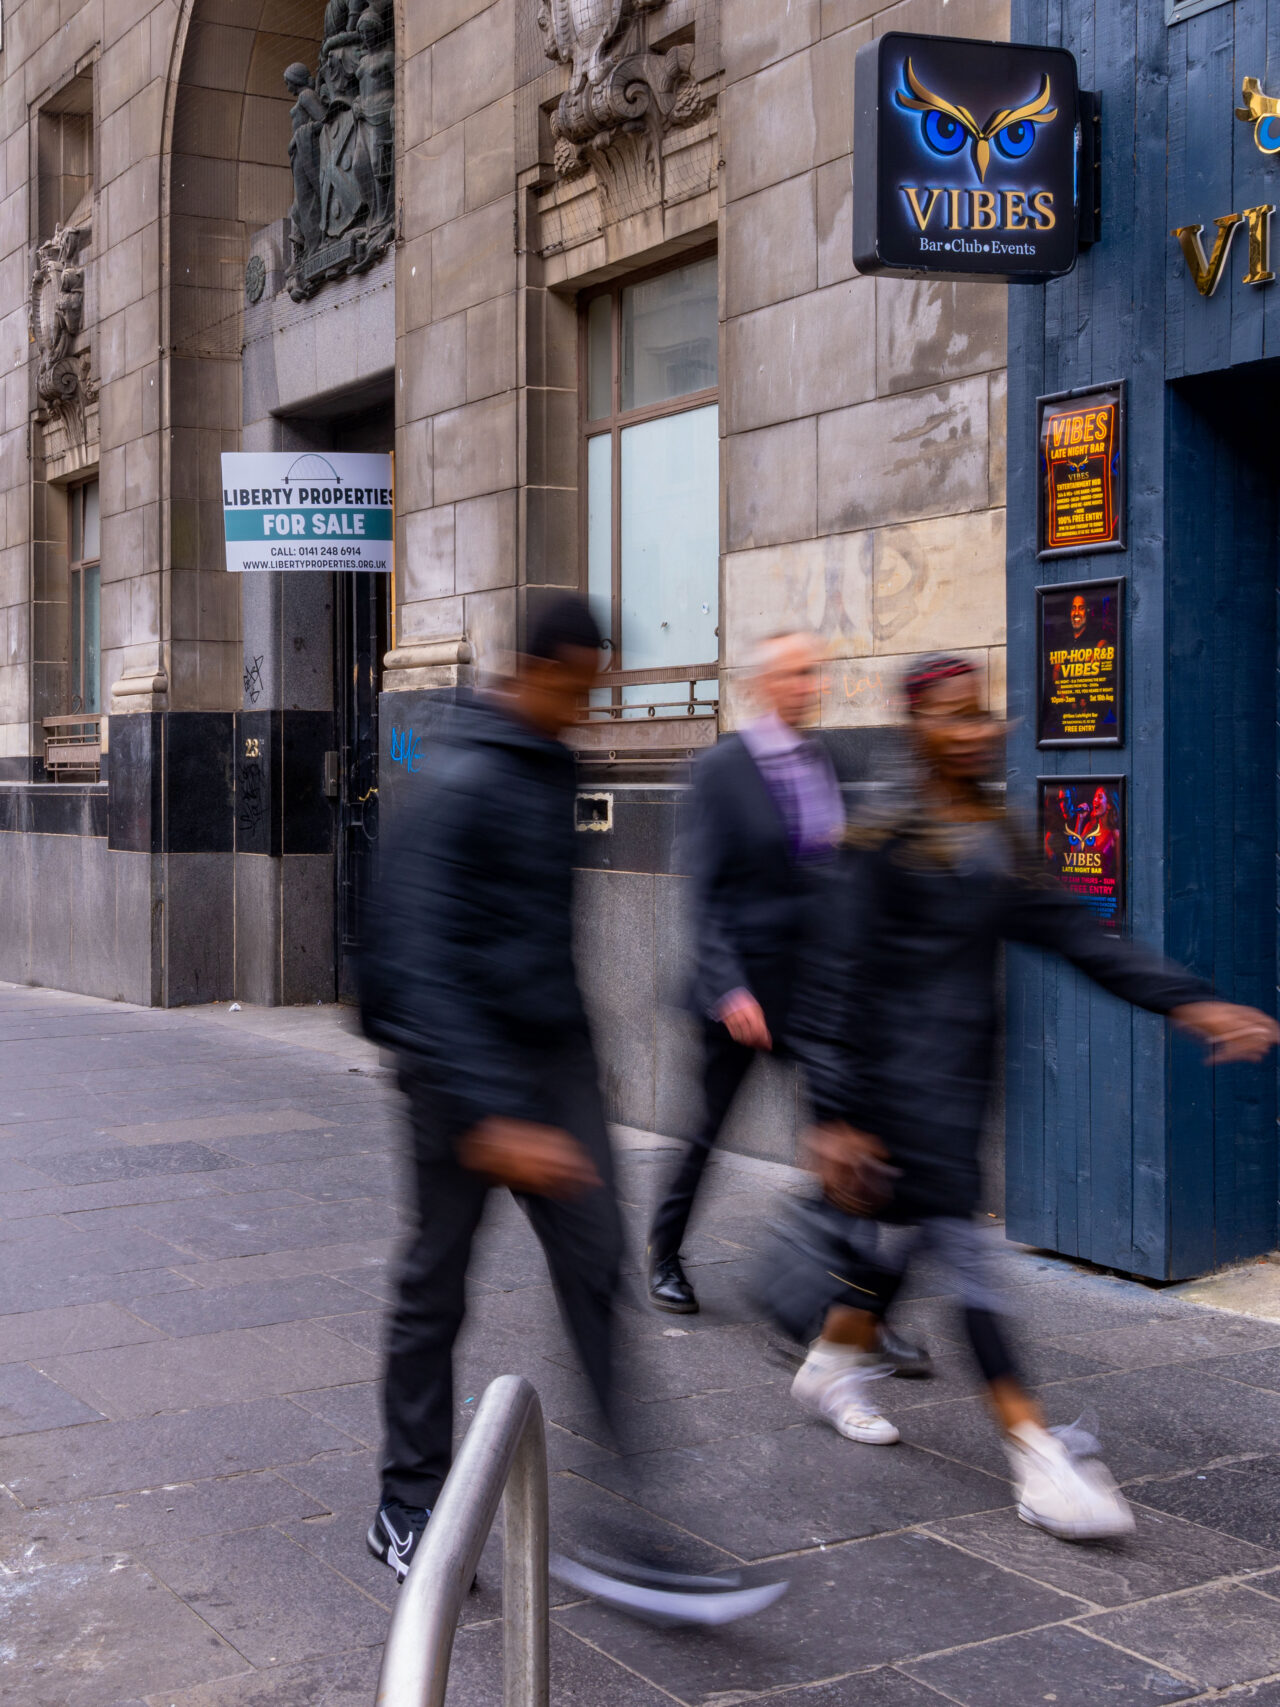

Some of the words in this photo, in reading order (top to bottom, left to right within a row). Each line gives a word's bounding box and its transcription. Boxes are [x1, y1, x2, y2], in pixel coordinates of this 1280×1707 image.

[901, 186, 1056, 232] VIBES
[1053, 411, 1108, 447] VIBES
[1051, 447, 1067, 460] LATE
[1067, 444, 1089, 457] NIGHT
[1089, 442, 1105, 453] BAR
[1068, 471, 1089, 481] VIBES
[224, 487, 293, 506] LIBERTY
[263, 514, 305, 535] FOR
[312, 513, 365, 535] SALE
[1072, 514, 1085, 523] FREE
[1085, 511, 1103, 521] ENTRY
[270, 547, 296, 556] CALL:
[298, 547, 318, 556] 0141
[320, 547, 338, 556] 248
[340, 547, 361, 556] 6914
[243, 560, 387, 570] WWW.LIBERTYPROPERTIES.ORG.UK
[1049, 648, 1092, 665] HIP-HOP
[1093, 646, 1115, 660] R&B
[1061, 662, 1100, 678] VIBES
[1064, 725, 1078, 733] FREE
[1063, 852, 1101, 866] VIBES
[1070, 885, 1088, 894] FREE
[1089, 886, 1113, 895] ENTRY
